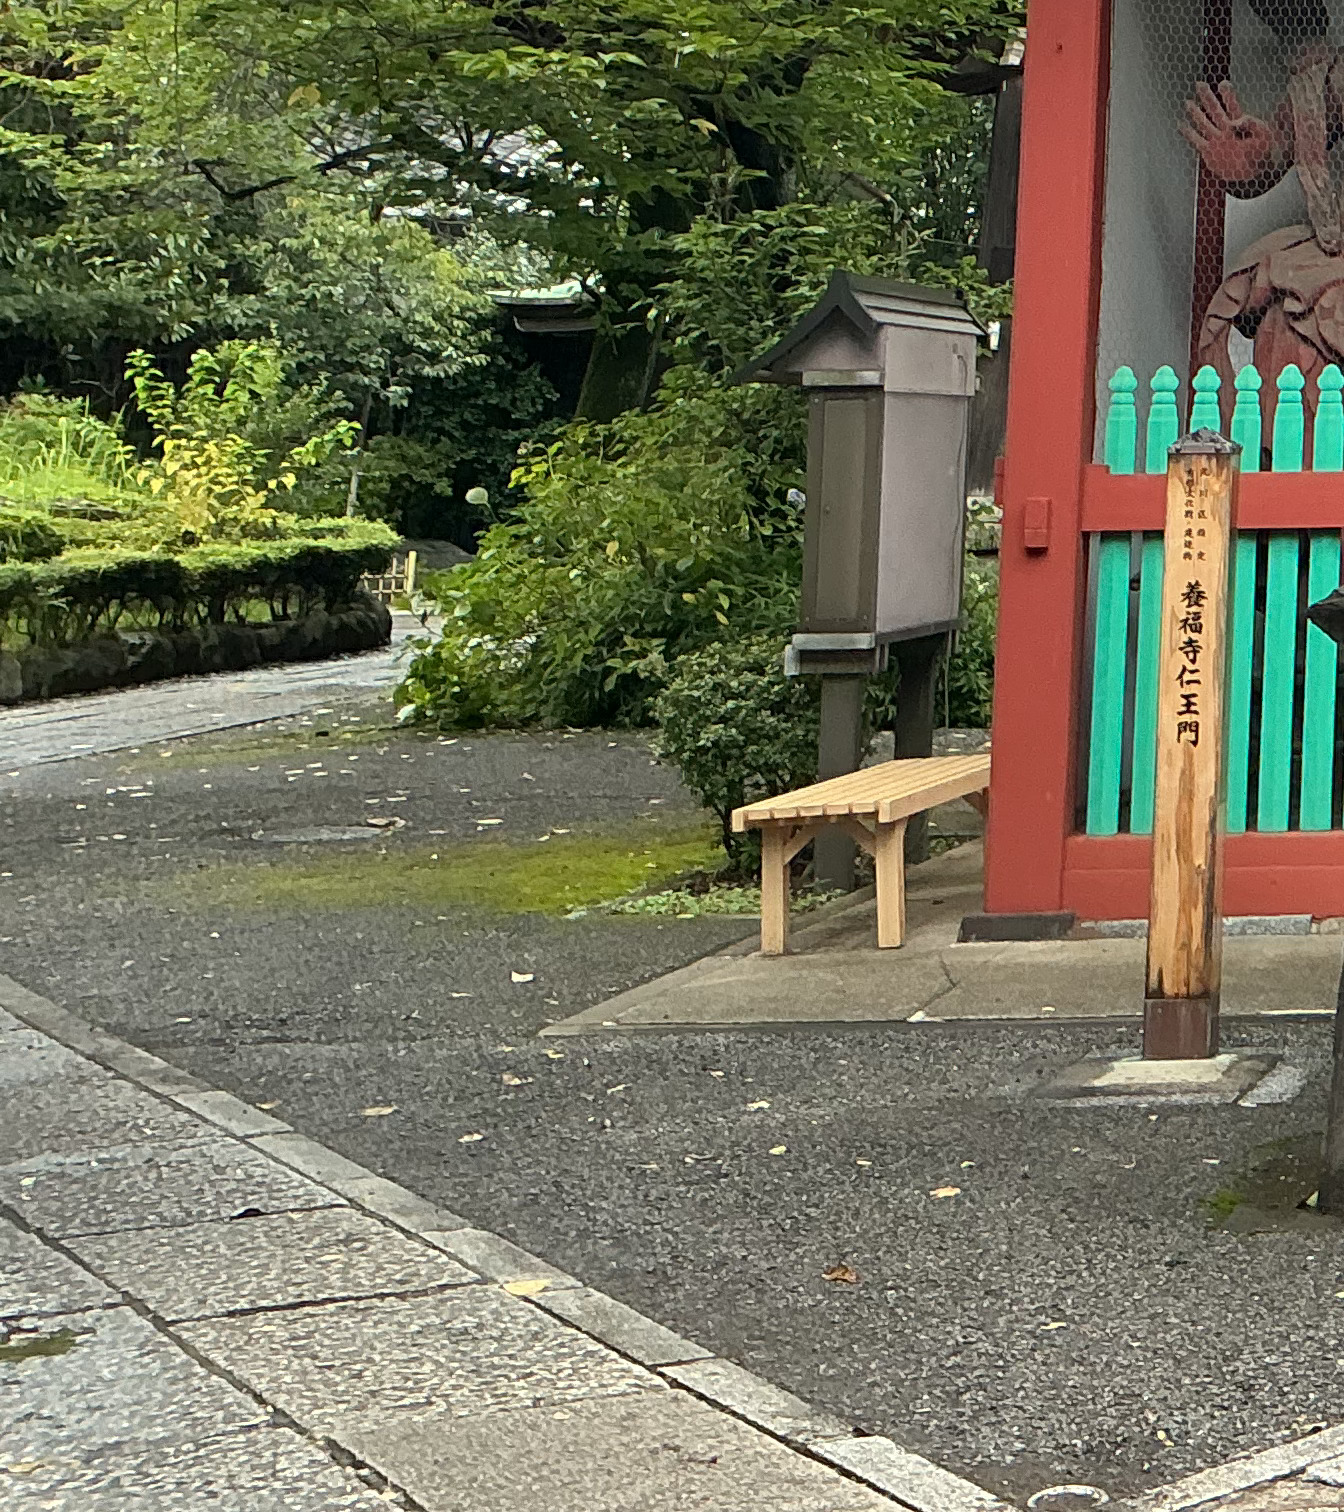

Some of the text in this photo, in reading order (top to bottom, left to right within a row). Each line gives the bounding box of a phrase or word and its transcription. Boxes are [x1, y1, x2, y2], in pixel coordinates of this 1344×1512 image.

[1175, 580, 1209, 748] 養福寺仁王門
